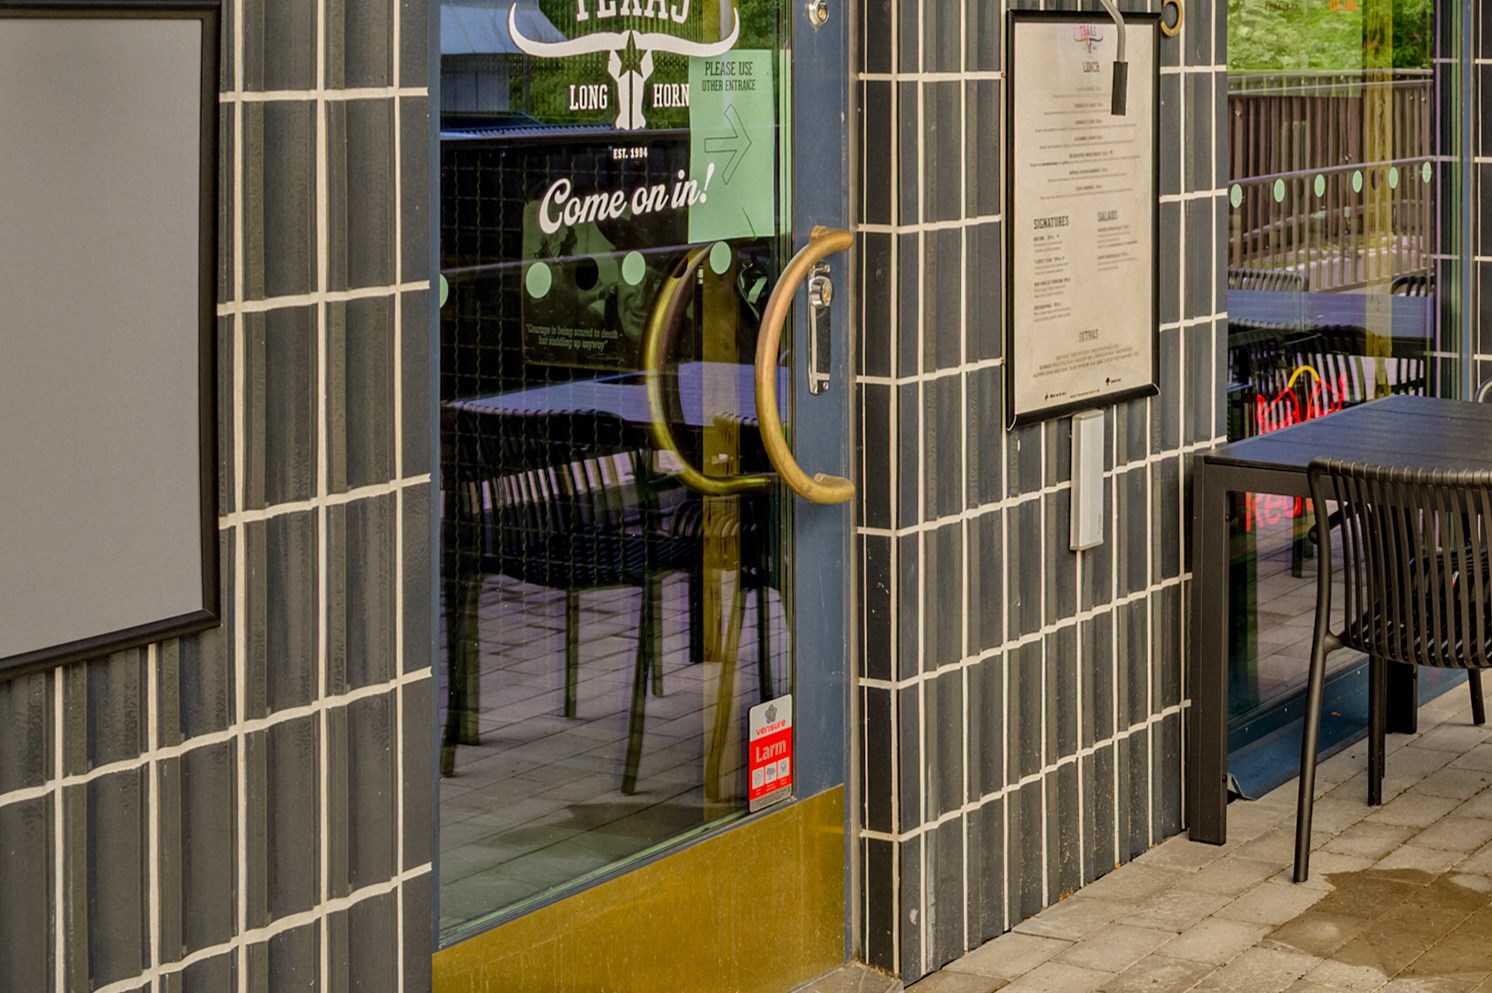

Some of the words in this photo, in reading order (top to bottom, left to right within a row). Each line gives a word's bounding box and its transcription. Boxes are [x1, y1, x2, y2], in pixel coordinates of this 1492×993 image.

[705, 61, 736, 76] PLEASE
[739, 61, 753, 76] USE
[702, 79, 723, 91] OTHER
[725, 79, 756, 91] ENTRANCE
[569, 84, 608, 110] LONG
[653, 83, 690, 108] HORN
[613, 148, 629, 159] EST.
[630, 147, 648, 158] 1994
[539, 178, 627, 235] Come
[631, 183, 669, 215] on
[671, 162, 715, 209] in!
[1033, 215, 1069, 230] SIGNATURES
[755, 739, 787, 763] Larm
